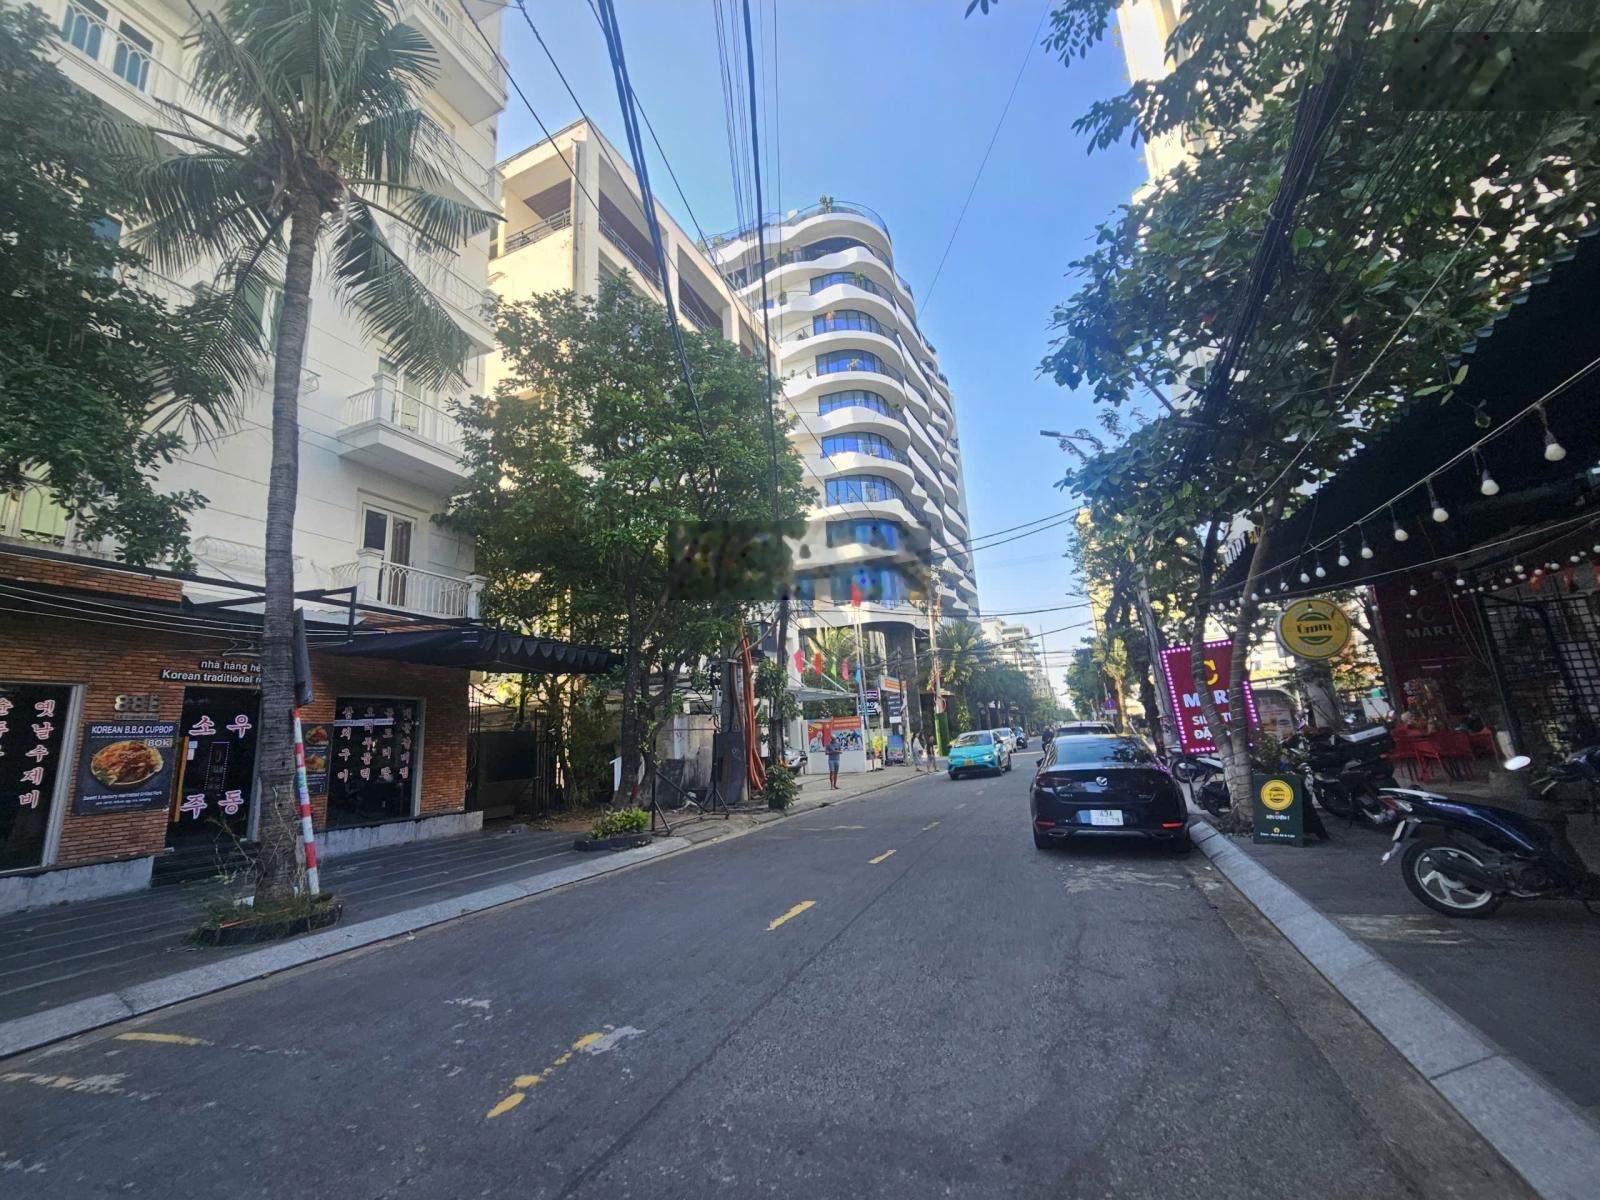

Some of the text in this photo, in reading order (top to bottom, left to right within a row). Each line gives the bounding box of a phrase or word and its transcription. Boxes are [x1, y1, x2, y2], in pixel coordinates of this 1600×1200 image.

[1405, 624, 1455, 639] MART
[162, 669, 200, 681] Korean
[203, 673, 252, 683] traditional
[1182, 689, 1231, 708] MR
[91, 725, 174, 734] KOREAN B.B.Q CUPBOP
[19, 699, 55, 809] 옛날수제비
